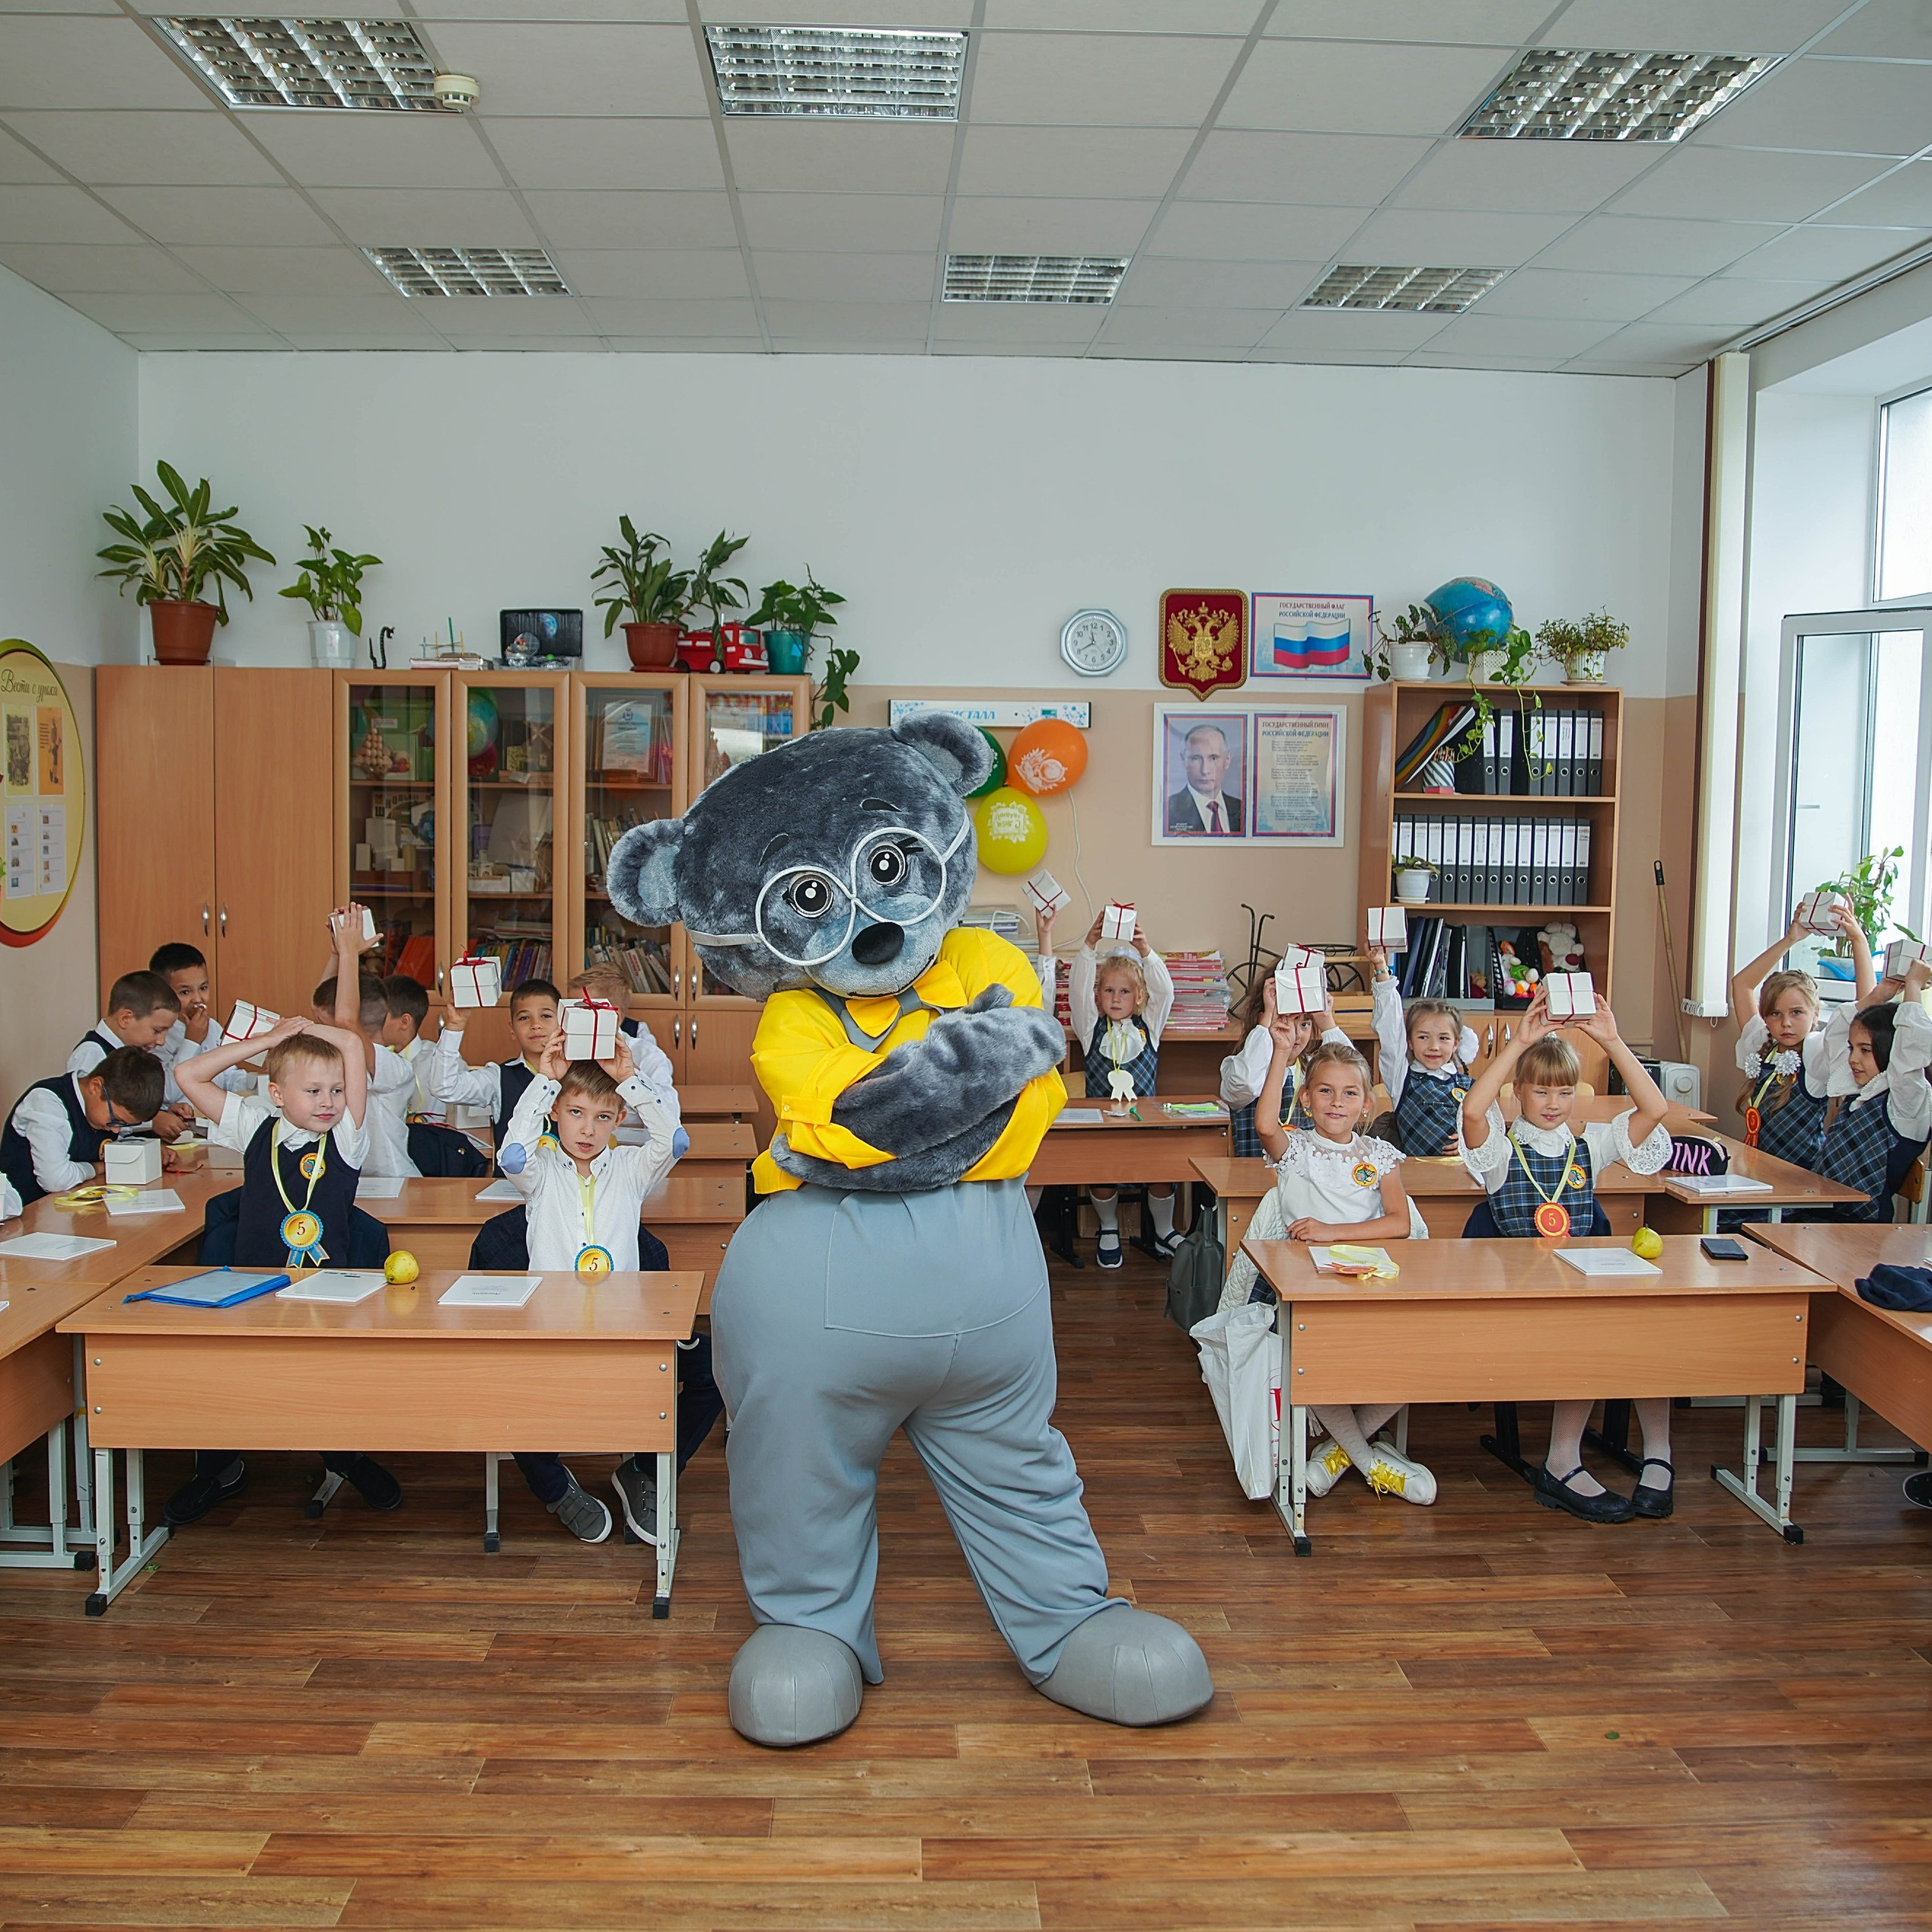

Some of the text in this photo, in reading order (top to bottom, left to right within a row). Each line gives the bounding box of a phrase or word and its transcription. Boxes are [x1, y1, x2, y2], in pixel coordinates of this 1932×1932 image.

[1279, 610, 1313, 618] РОССИЙСКОЙ
[1671, 1143, 1712, 1177] INK
[1548, 1212, 1556, 1226] 5
[297, 1221, 306, 1236] 5
[589, 1257, 598, 1272] 5
